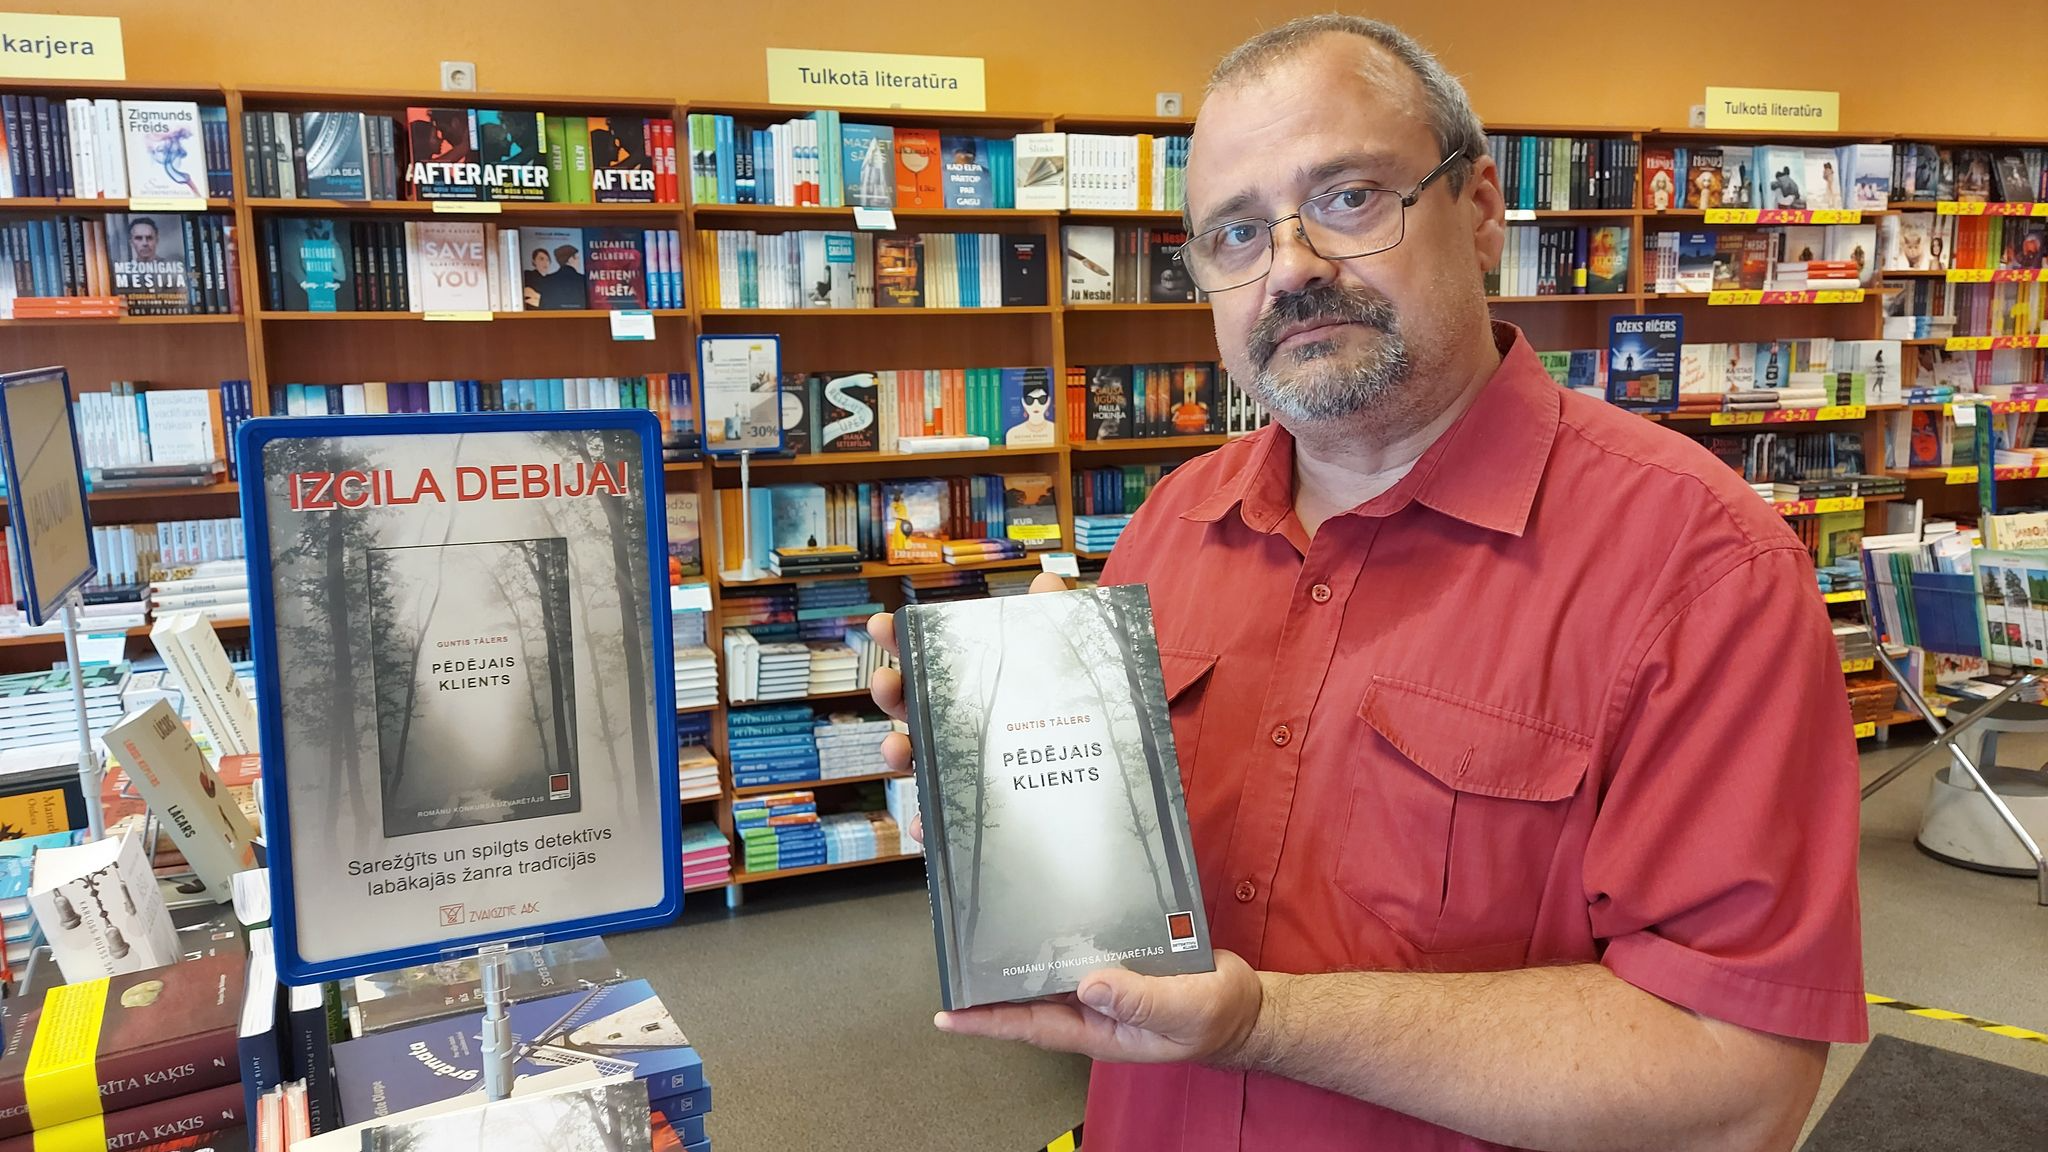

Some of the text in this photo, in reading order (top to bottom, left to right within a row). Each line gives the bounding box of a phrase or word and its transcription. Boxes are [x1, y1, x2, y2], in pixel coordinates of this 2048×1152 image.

[2, 33, 95, 59] karjera
[799, 67, 959, 90] Tulkotā literatūra
[128, 108, 192, 122] Zigmunds
[1725, 101, 1823, 117] Tulkotā literatūra
[130, 121, 169, 133] Freids
[575, 145, 586, 171] AFTER
[413, 162, 481, 185] AFTER
[483, 164, 549, 188] AFTER
[593, 169, 655, 191] AFTER
[425, 242, 483, 260] SAVE
[589, 240, 635, 249] ELIZABETE
[114, 259, 185, 274] MEŽONĪGAIS
[591, 252, 636, 260] GILBERTA
[116, 273, 186, 288] MESIJA
[433, 271, 479, 288] YOU
[1616, 318, 1676, 333] DŽEKS RĪČERS
[1099, 404, 1121, 412] PAULA
[747, 425, 779, 438] -30%
[289, 460, 629, 511] IZCILA DEBIJA!
[1013, 517, 1033, 525] KUR
[436, 634, 508, 649] GUNTIS TĀLERS
[432, 655, 516, 675] PĒDĒJAIS
[439, 674, 511, 692] KLIENTS
[1006, 715, 1091, 732] GUNTIS TĀLERS
[1003, 742, 1103, 767] PĒDĒJAIS
[1013, 767, 1100, 791] KLIENTS
[417, 795, 545, 818] ROMĀNU KONKURSA UZVARĒTĀJS
[348, 825, 612, 878] Sarežģīts un spilgts detektīvs
[367, 850, 597, 897] labākajās žanra tradīcijās
[469, 901, 540, 922] ZVAIGZNE ABC
[1003, 946, 1164, 977] ROMĀNU KONKURSA UZVARĒTĀJS
[253, 1056, 262, 1078] Juris
[408, 1041, 480, 1081] grāmata
[144, 1063, 195, 1084] KAĶIS
[107, 1130, 150, 1150] RĪTA
[153, 1115, 205, 1136] KAĶIS
